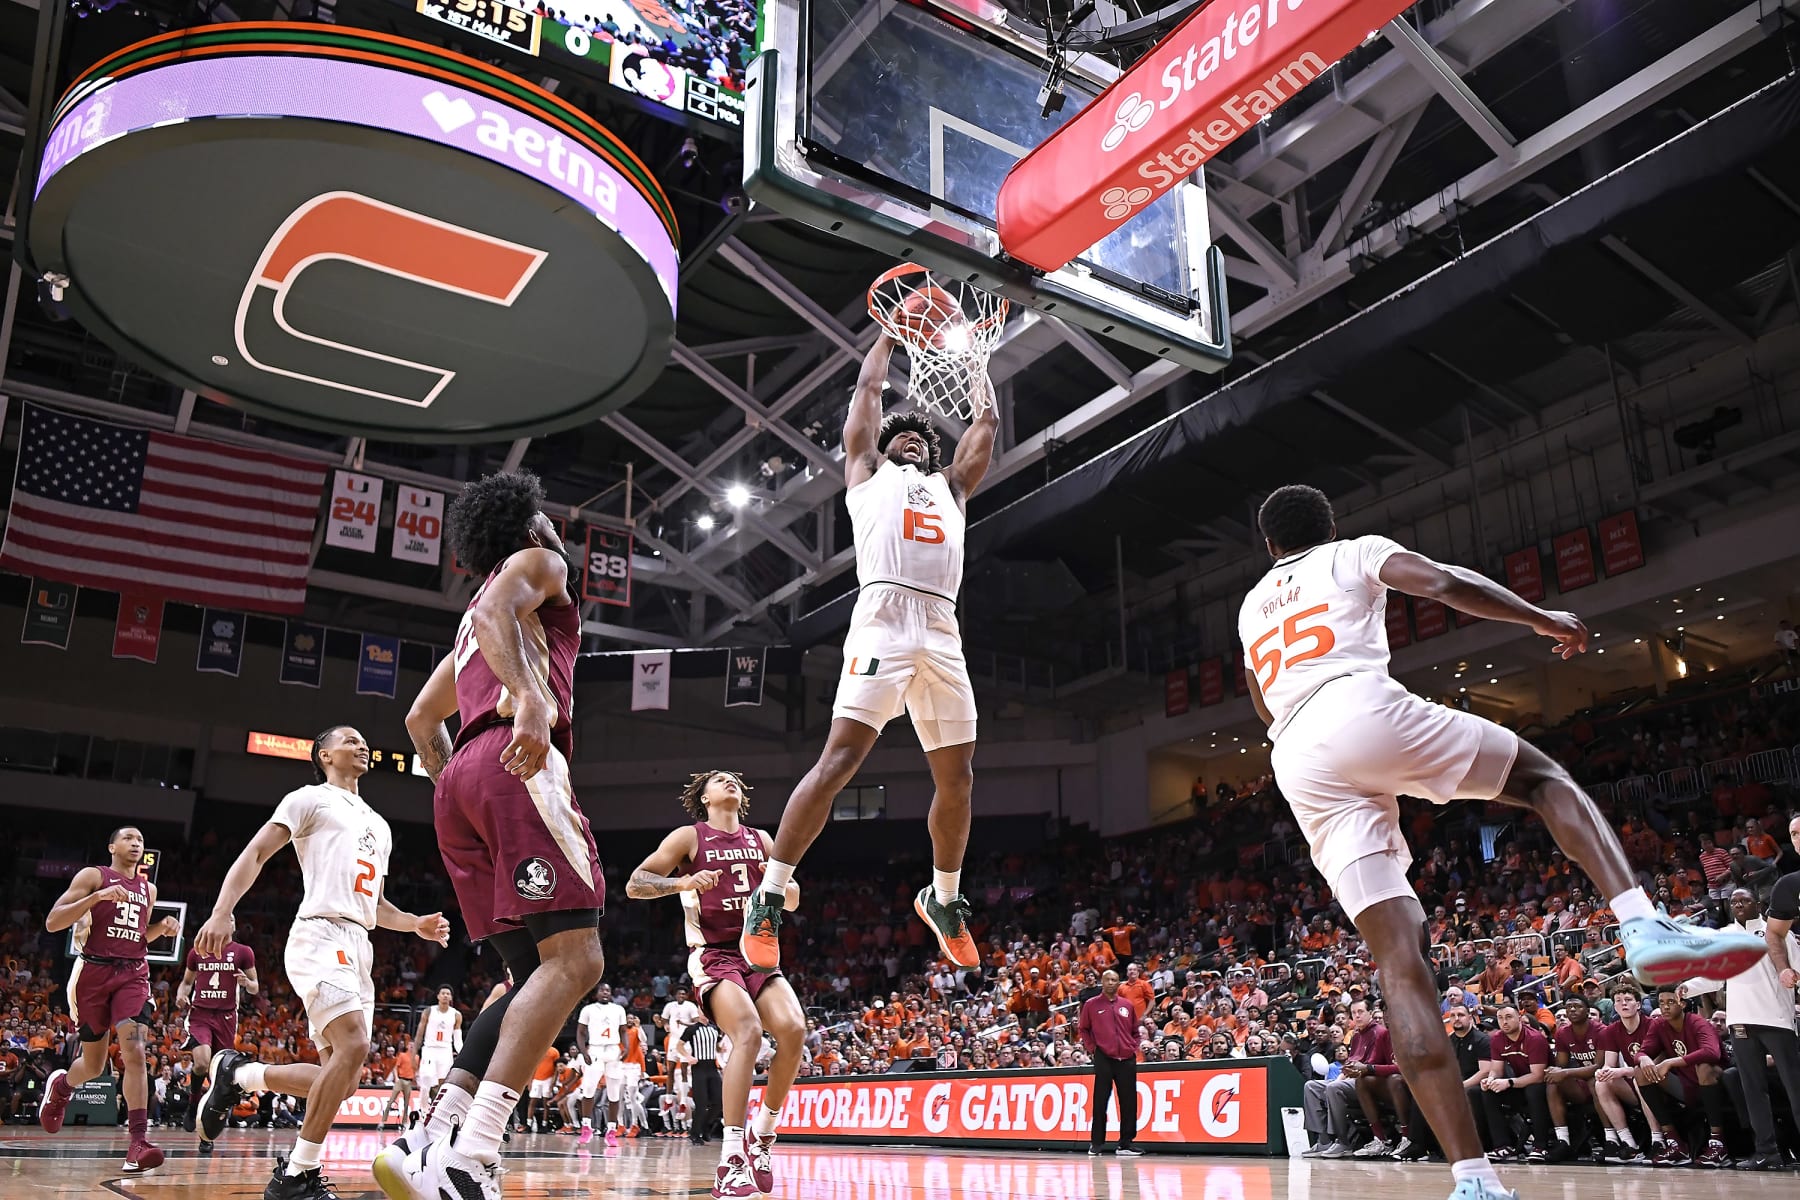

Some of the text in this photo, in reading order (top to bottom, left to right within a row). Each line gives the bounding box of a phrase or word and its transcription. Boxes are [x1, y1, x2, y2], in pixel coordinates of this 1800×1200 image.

[472, 20, 512, 41] HALF
[564, 26, 591, 56] 0
[476, 110, 618, 216] aetna
[332, 496, 376, 527] 24
[397, 511, 440, 540] 40
[903, 508, 946, 545] 15
[589, 552, 627, 579] 33
[1249, 602, 1336, 696] 55
[640, 662, 664, 675] VT
[143, 853, 155, 866] 15
[704, 848, 765, 863] FLORIDA
[354, 858, 376, 898] 2
[730, 863, 751, 893] 3
[114, 901, 141, 929] 35
[106, 926, 141, 943] STATE
[198, 962, 235, 971] FLORIDA
[208, 971, 220, 990] 4
[200, 990, 228, 999] STATE
[436, 1031, 443, 1042] 11
[600, 1027, 611, 1039] 4
[775, 1087, 913, 1129] ATORADE
[922, 1082, 952, 1133] G
[1198, 1072, 1242, 1138] G
